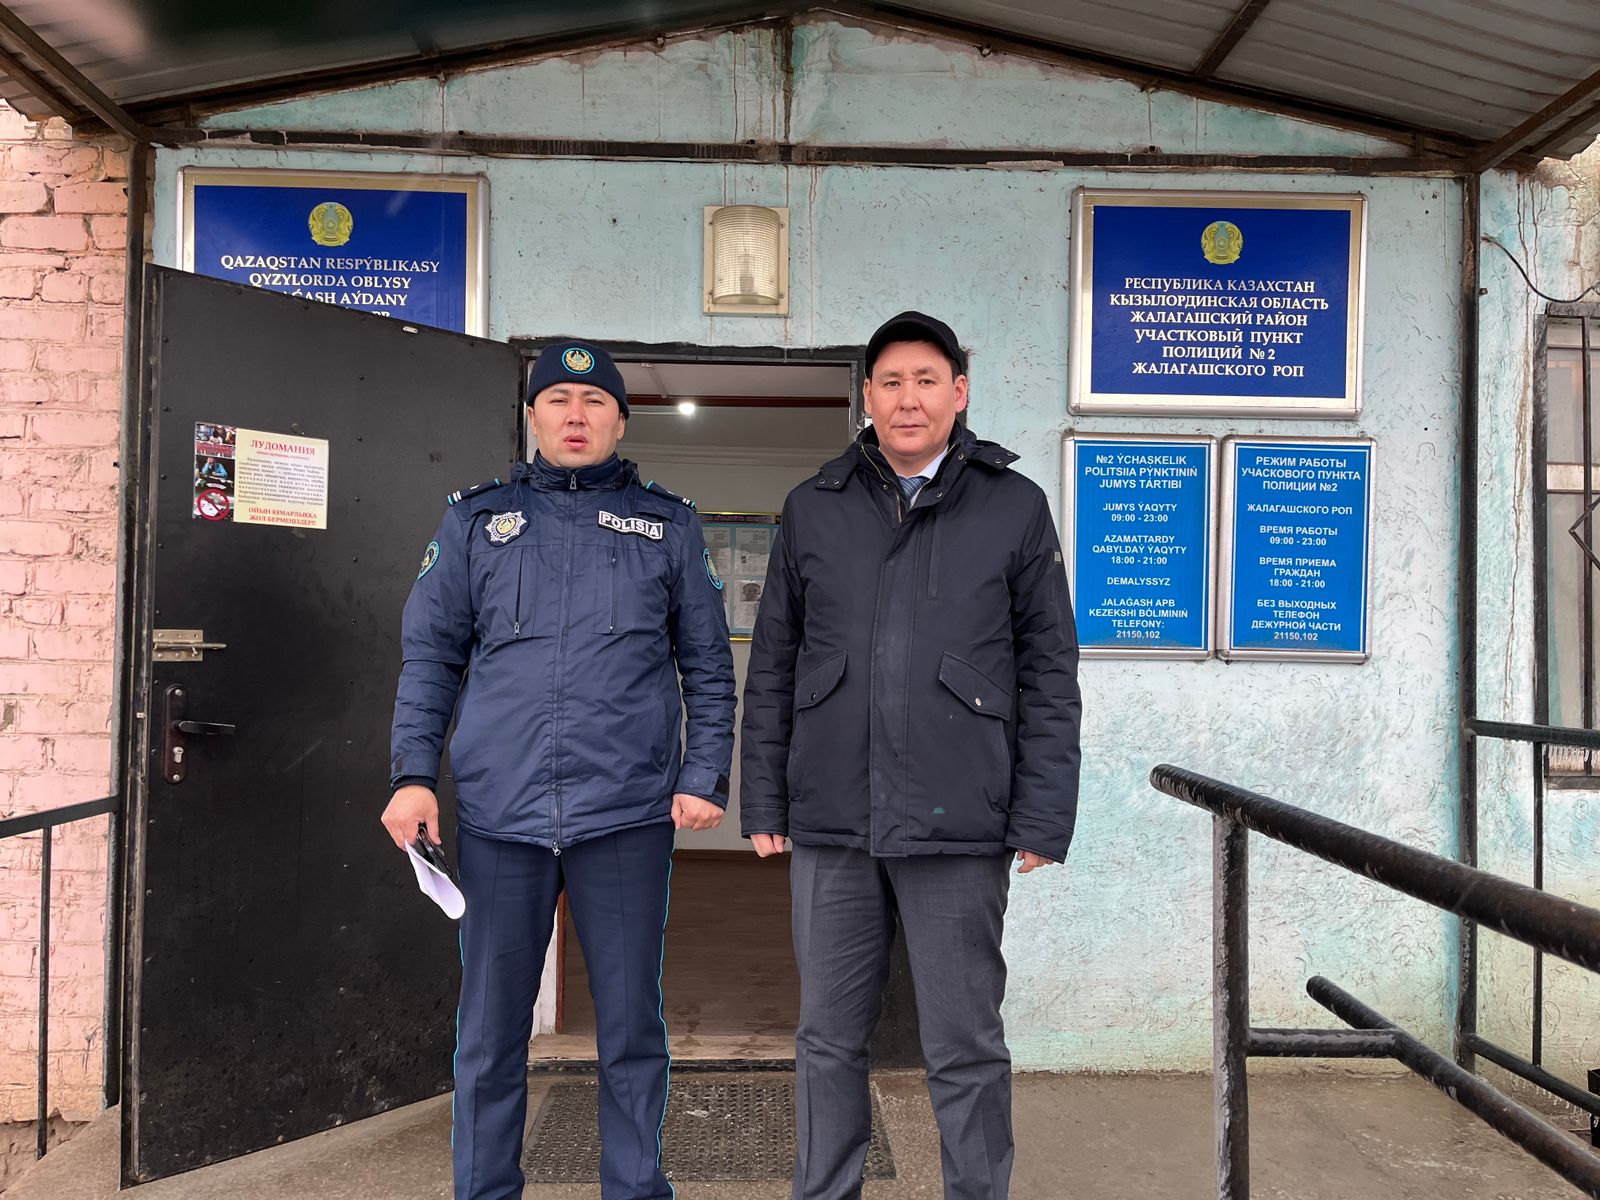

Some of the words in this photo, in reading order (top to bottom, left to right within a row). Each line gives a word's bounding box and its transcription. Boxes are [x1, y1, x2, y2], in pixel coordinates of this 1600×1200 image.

[221, 255, 321, 271] QAZAQSTAN
[325, 256, 440, 273] RESPÝBLIKASY
[250, 273, 347, 287] QYZYLORDA
[352, 276, 412, 289] OBLYSY
[1125, 277, 1223, 292] РЕСПУБЛИКА
[1227, 280, 1315, 293] КАЗАХСТАН
[341, 290, 407, 306] AÝDANY
[1110, 294, 1258, 309] КЫЗЫЛОРДИНСКАЯ
[1261, 297, 1329, 310] ОБЛАСТЬ
[1130, 311, 1252, 325] ЖАЛАГАШСКИЙ
[1256, 312, 1308, 327] РАЙОН
[1135, 328, 1243, 343] УЧАСТКОВЫЙ
[1250, 332, 1303, 344] ПУНКТ
[1162, 345, 1242, 361] ПОЛИЦИЙ
[1132, 362, 1265, 376] ЖАЛАГАШСКОГО
[1273, 365, 1304, 377] РОП
[250, 440, 315, 455] ЛУДОМАНИЯ
[1096, 455, 1114, 464] №2
[1256, 456, 1296, 466] РЕЖИМ
[1300, 458, 1346, 468] РАБОТЫ
[1085, 466, 1136, 476] POLITSIIA
[1242, 468, 1314, 479] УЧАСКОВОГО
[1318, 471, 1361, 480] ПУНКТА
[1099, 479, 1136, 488] JUMYS
[1263, 481, 1316, 492] ПОЛИЦИИ
[1320, 483, 1338, 492] №2
[1103, 503, 1135, 511] JUMYS
[1247, 504, 1329, 514] ЖАЛАГАШСКОГО
[1332, 506, 1352, 515] РОП
[1144, 514, 1168, 522] 23:00
[602, 513, 659, 537] POLISIA
[1260, 525, 1293, 534] ВРЕМЯ
[1296, 527, 1338, 536] РАБОТЫ
[1104, 535, 1175, 543] AZAMATTARDY
[1302, 538, 1326, 546] 23:00
[1111, 556, 1134, 564] 18:00
[1259, 557, 1293, 566] ВРЕМЯ
[1295, 558, 1336, 567] ПРИЕМА
[1274, 568, 1320, 578] ГРАЖДАН
[1107, 577, 1171, 586] DEMALYSSYZ
[1270, 579, 1293, 587] 18:00
[1301, 580, 1325, 588] 21:00
[1155, 599, 1175, 607] APB
[1257, 599, 1276, 608] БЕЗ
[1278, 600, 1337, 610] ВЫХОДНЫХ
[1089, 608, 1136, 617] KEZEKSHI
[1273, 610, 1320, 619] ТЕЛЕФОН
[1112, 619, 1165, 628] TELEFONY:
[1251, 619, 1306, 630] ДЕЖУРНОЙ
[1308, 622, 1341, 631] ЧАСТИ
